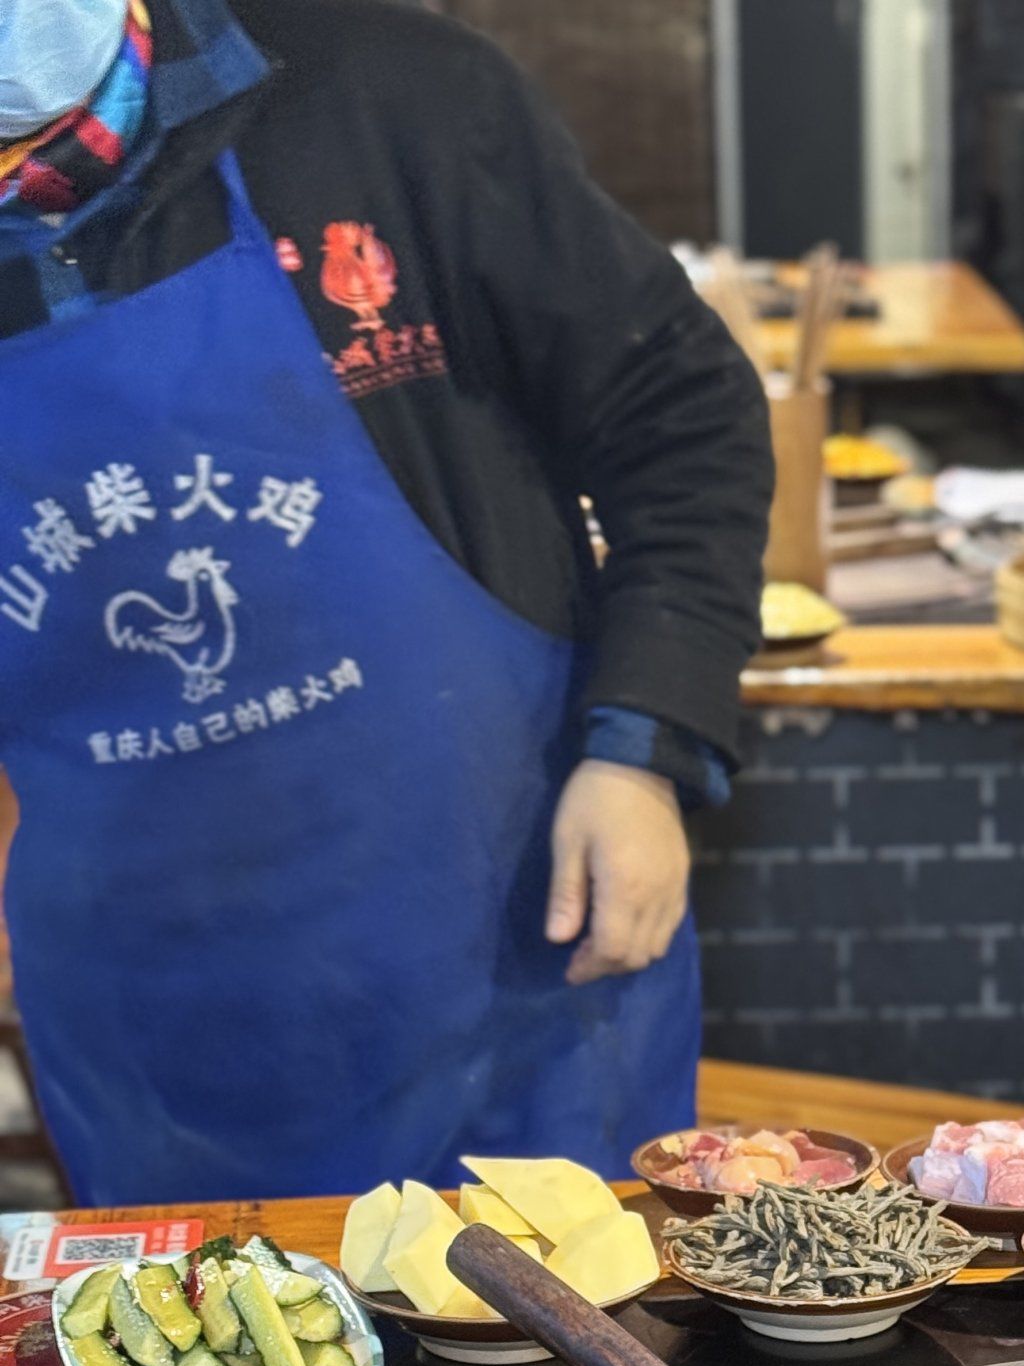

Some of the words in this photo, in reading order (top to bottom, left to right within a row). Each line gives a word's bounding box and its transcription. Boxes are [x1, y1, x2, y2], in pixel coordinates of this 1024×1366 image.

[0, 454, 323, 632] 山城柴火鸡
[87, 656, 363, 764] 重庆人自己的柴火鸡
